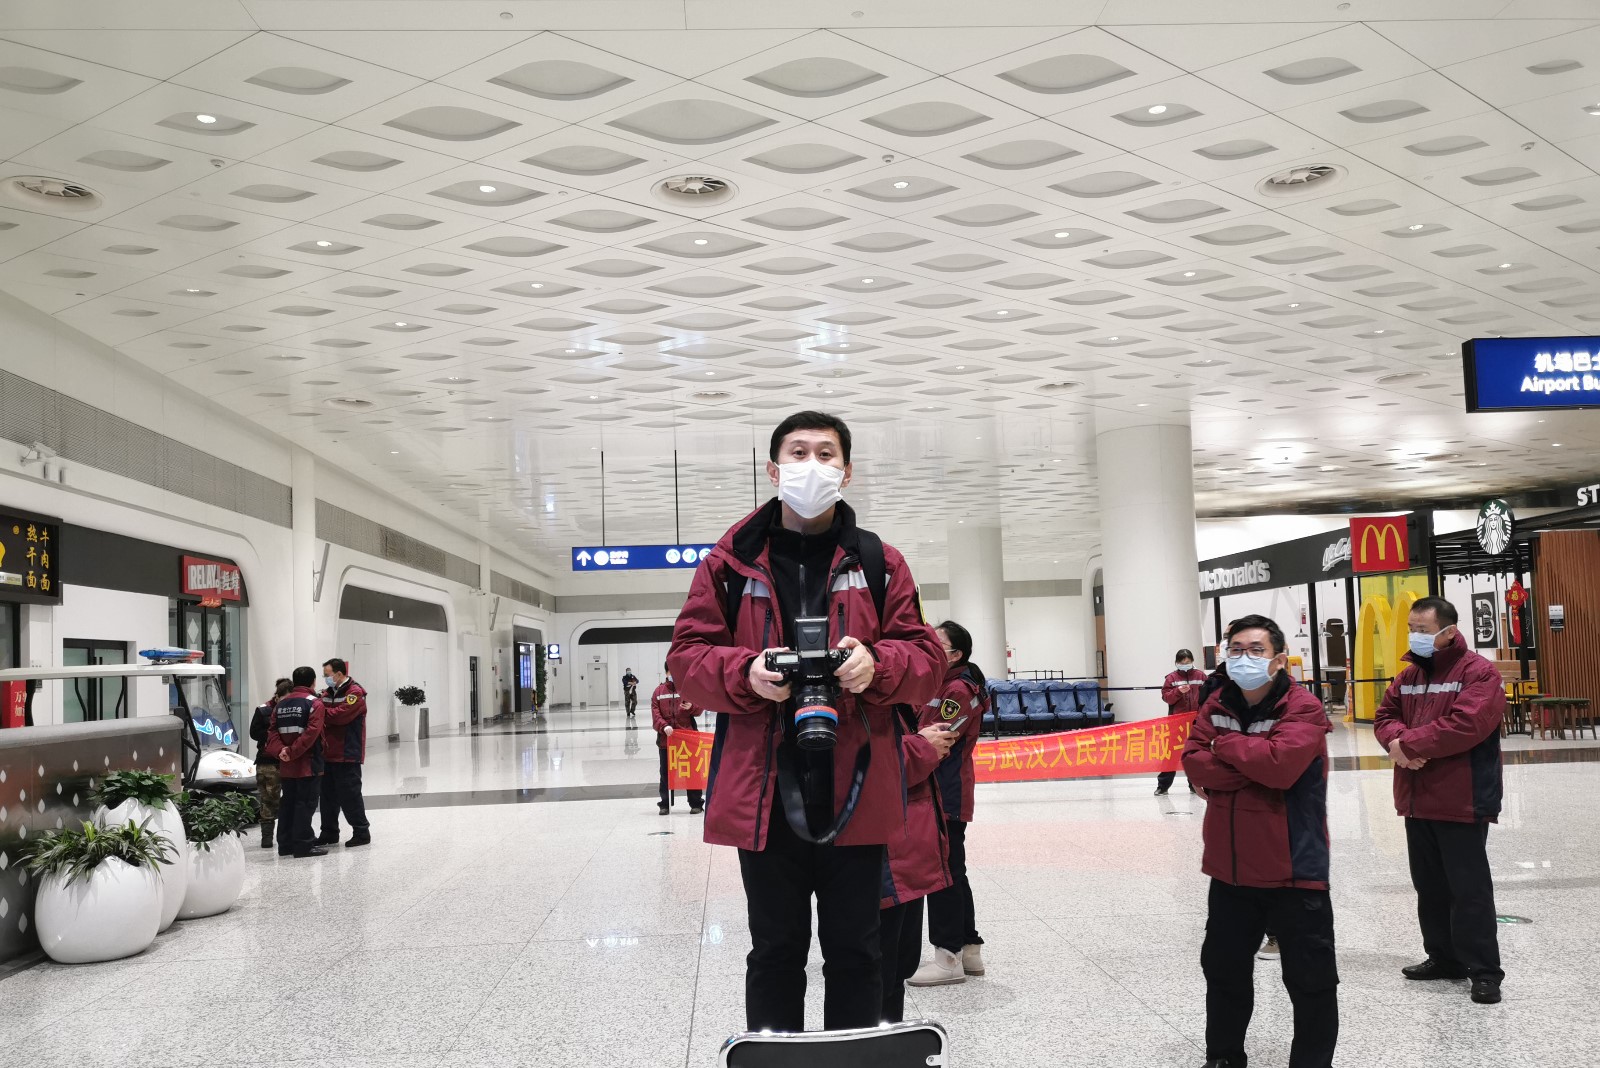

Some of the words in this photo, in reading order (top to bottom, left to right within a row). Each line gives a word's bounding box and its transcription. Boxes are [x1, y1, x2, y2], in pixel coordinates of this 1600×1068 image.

[1521, 376, 1580, 395] Airport
[1577, 484, 1600, 506] ST
[26, 523, 38, 589] 热干面
[40, 527, 50, 592] 牛肉面
[188, 564, 218, 590] RELAY
[668, 740, 713, 778] 哈尔
[975, 722, 1190, 773] 与武汉人民并肩战斗
